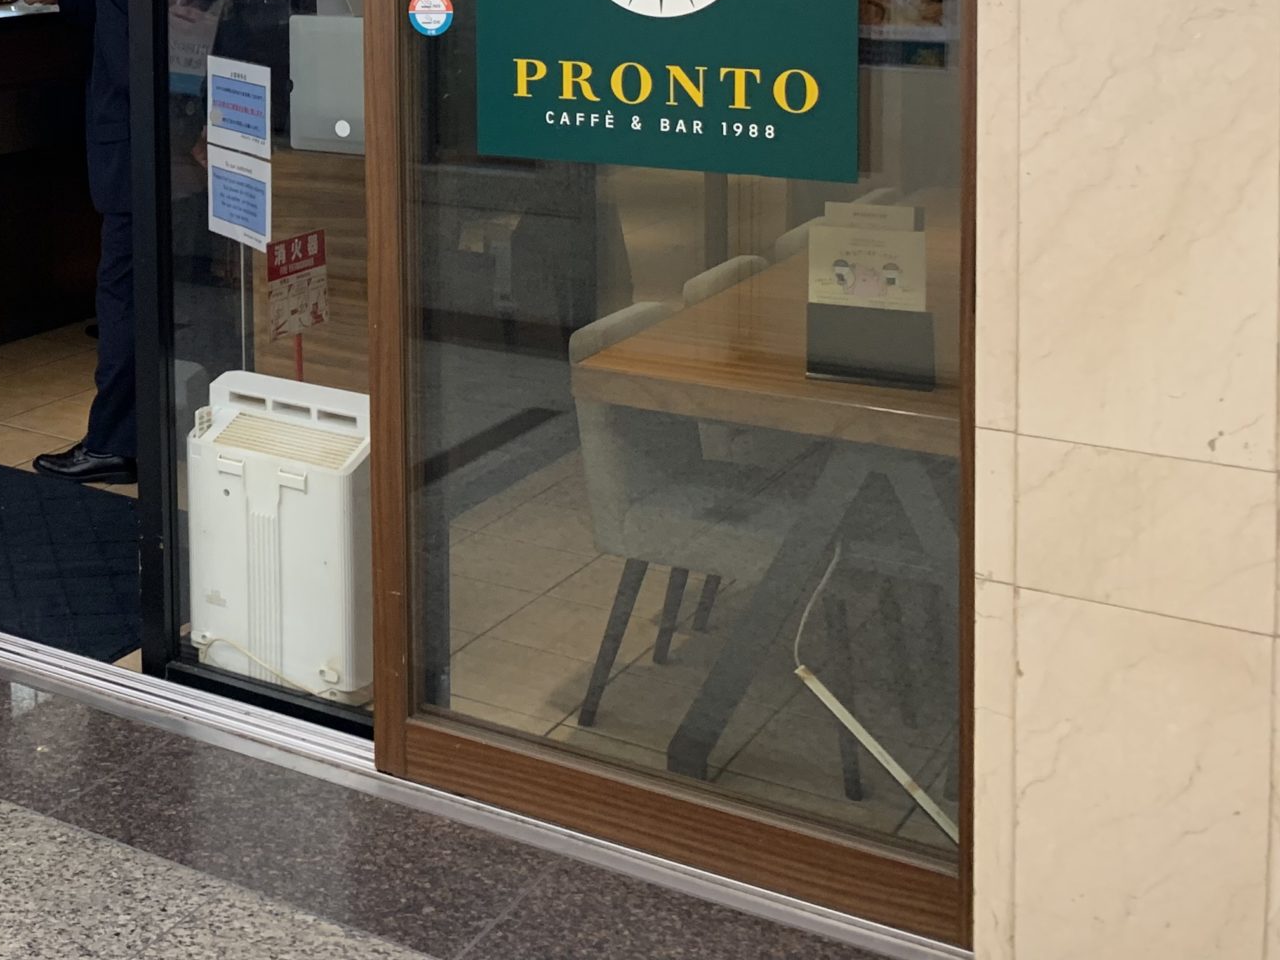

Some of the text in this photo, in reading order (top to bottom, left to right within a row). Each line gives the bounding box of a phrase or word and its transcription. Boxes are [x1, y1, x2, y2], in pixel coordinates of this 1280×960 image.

[512, 58, 819, 115] PRONTO
[545, 109, 776, 139] CAFFÈ & BAR 1988
[274, 234, 319, 266] 消火器
